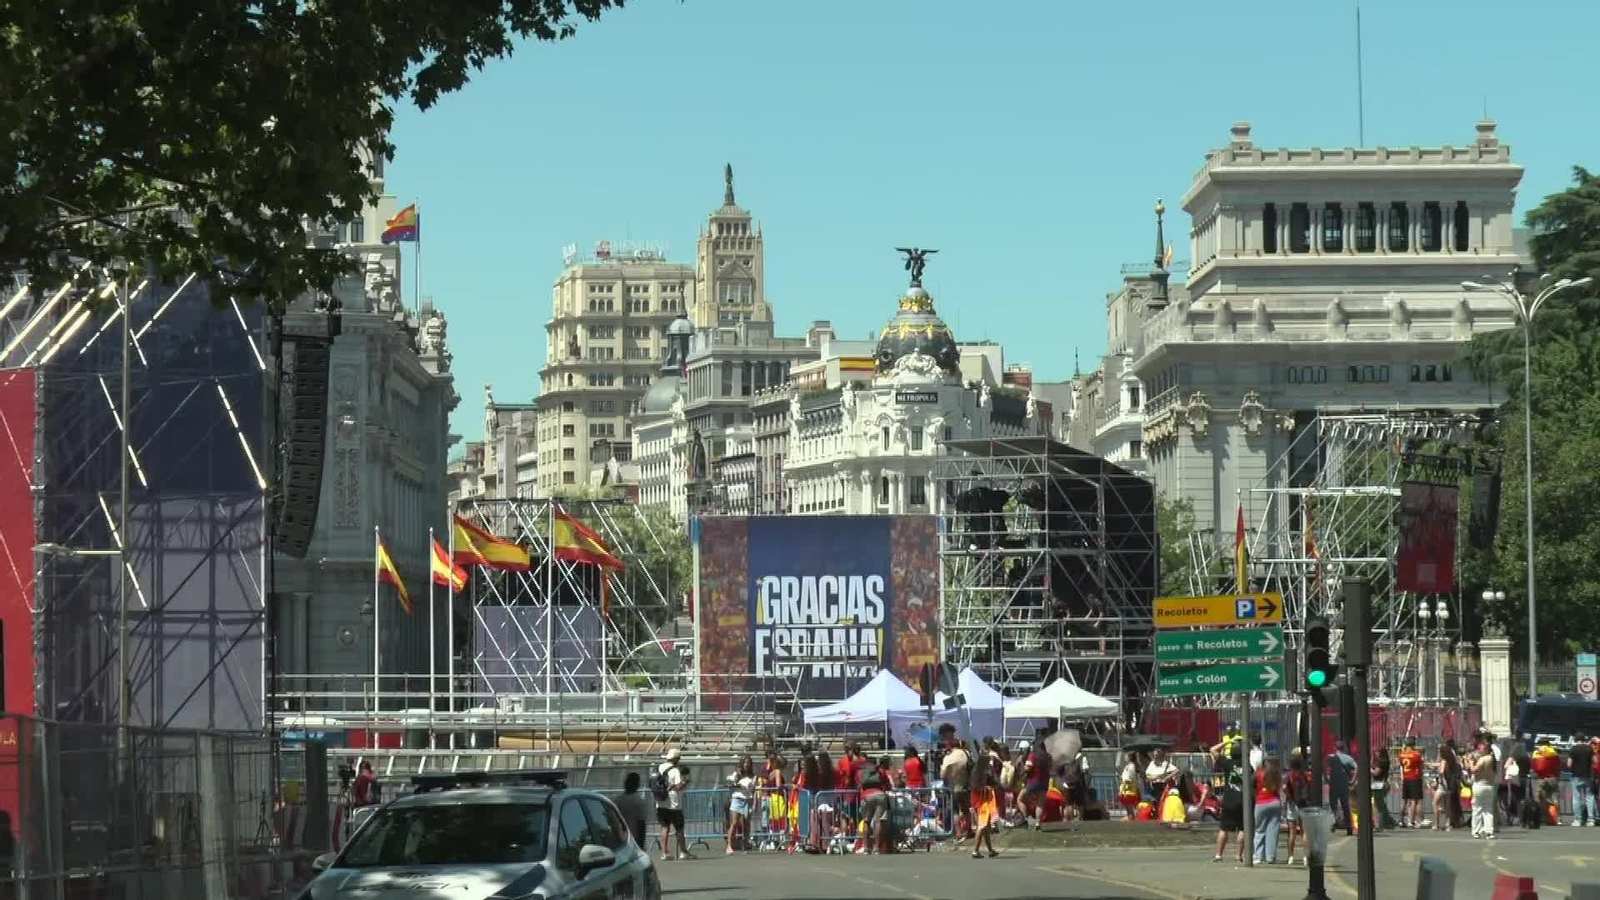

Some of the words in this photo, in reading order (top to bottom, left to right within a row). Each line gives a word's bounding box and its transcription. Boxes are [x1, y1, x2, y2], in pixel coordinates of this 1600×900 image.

[1157, 607, 1208, 617] Recoletos
[1237, 600, 1252, 617] P
[1196, 640, 1248, 650] Recoletos
